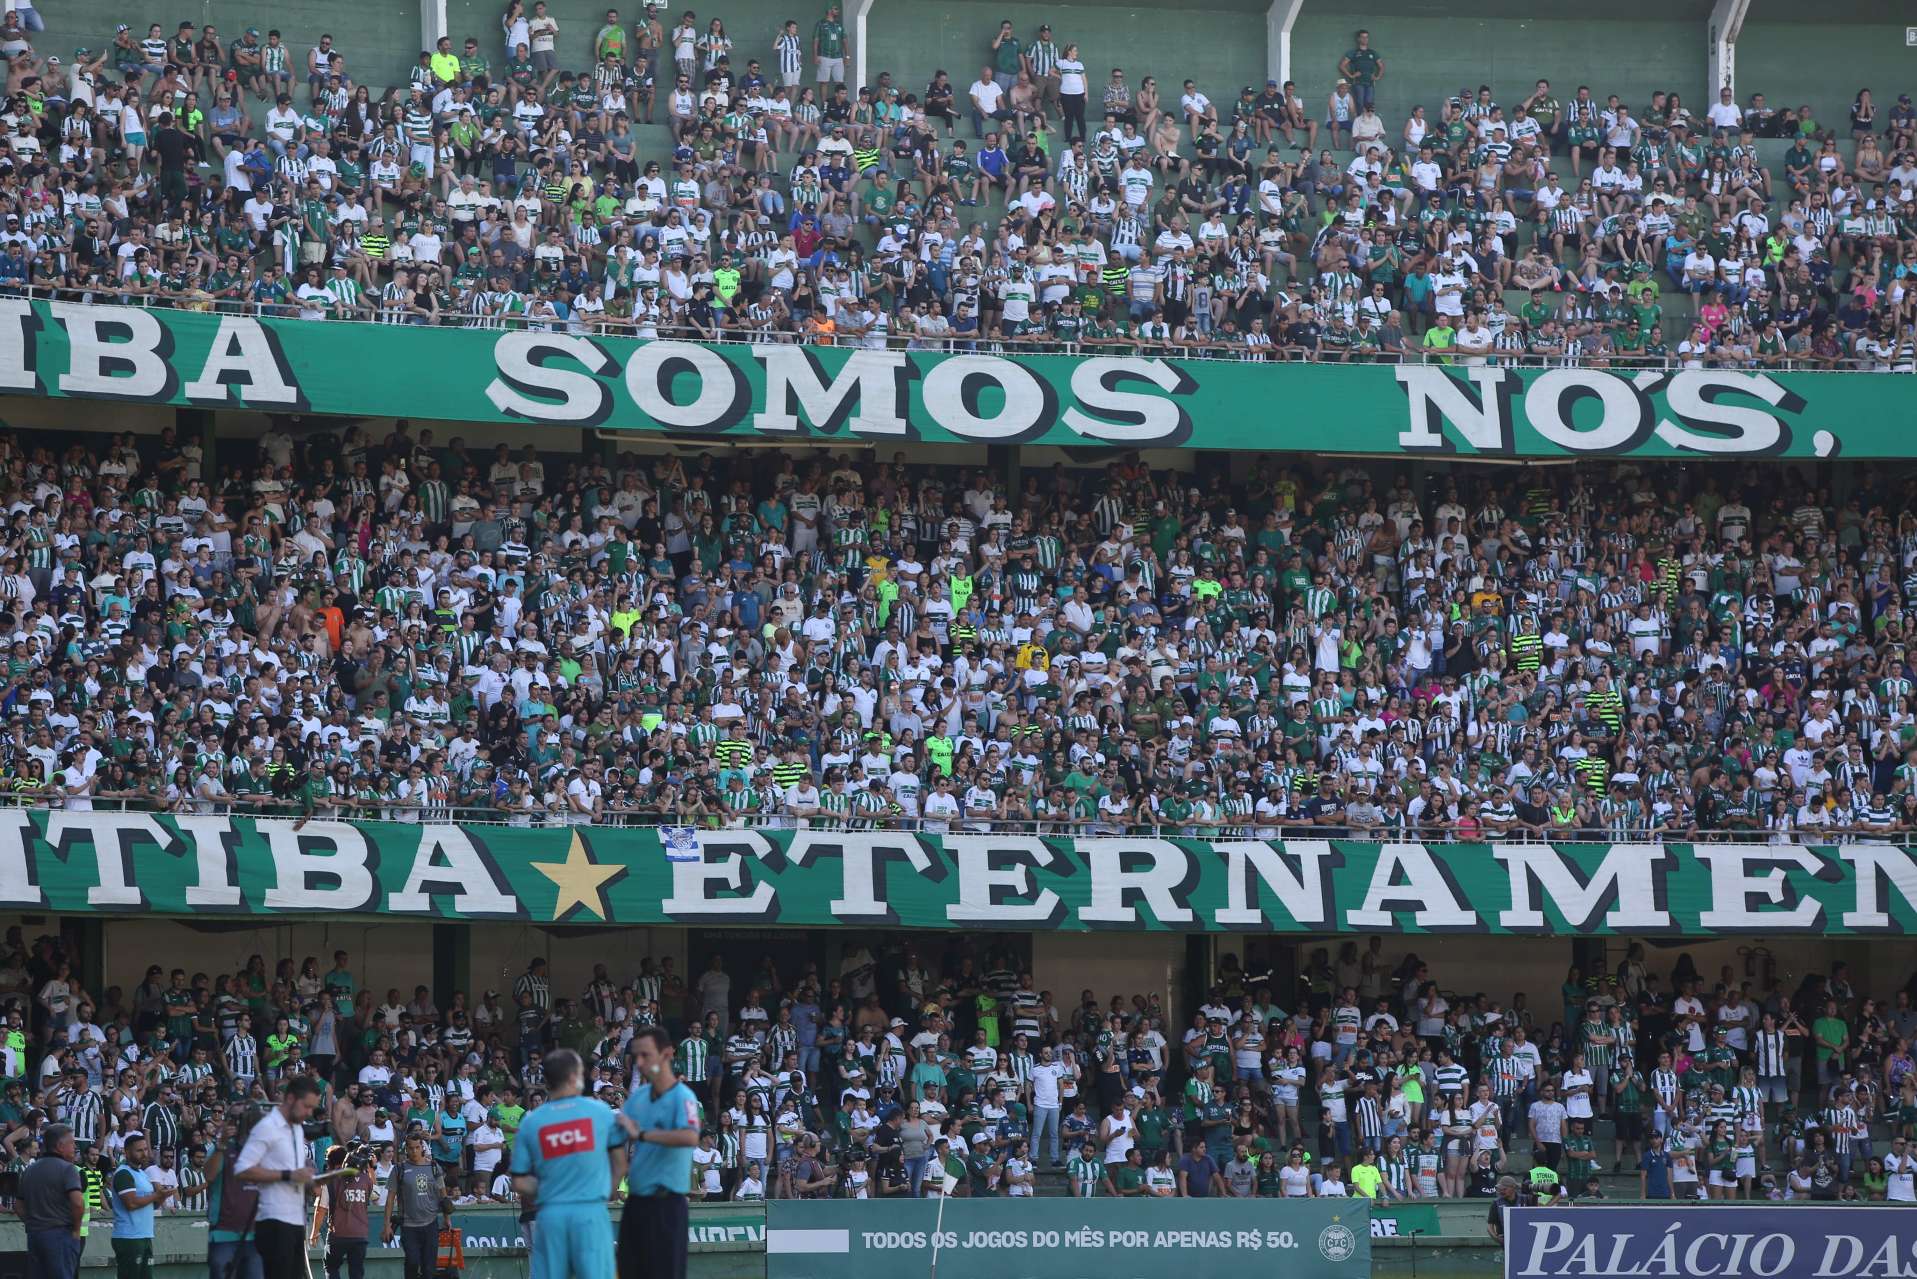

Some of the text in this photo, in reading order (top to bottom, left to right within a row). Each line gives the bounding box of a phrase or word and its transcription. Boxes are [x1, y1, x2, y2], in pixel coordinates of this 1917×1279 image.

[485, 331, 1182, 440] SOMOS
[1394, 365, 1835, 457] NÓS,
[658, 829, 1917, 928] ETERNAMEN
[546, 1129, 587, 1148] TCL
[862, 1224, 1299, 1250] TODOS OS JOGOS DO MÊS POR APENAS R$ 50.
[1517, 1221, 1796, 1277] PALÁCIO
